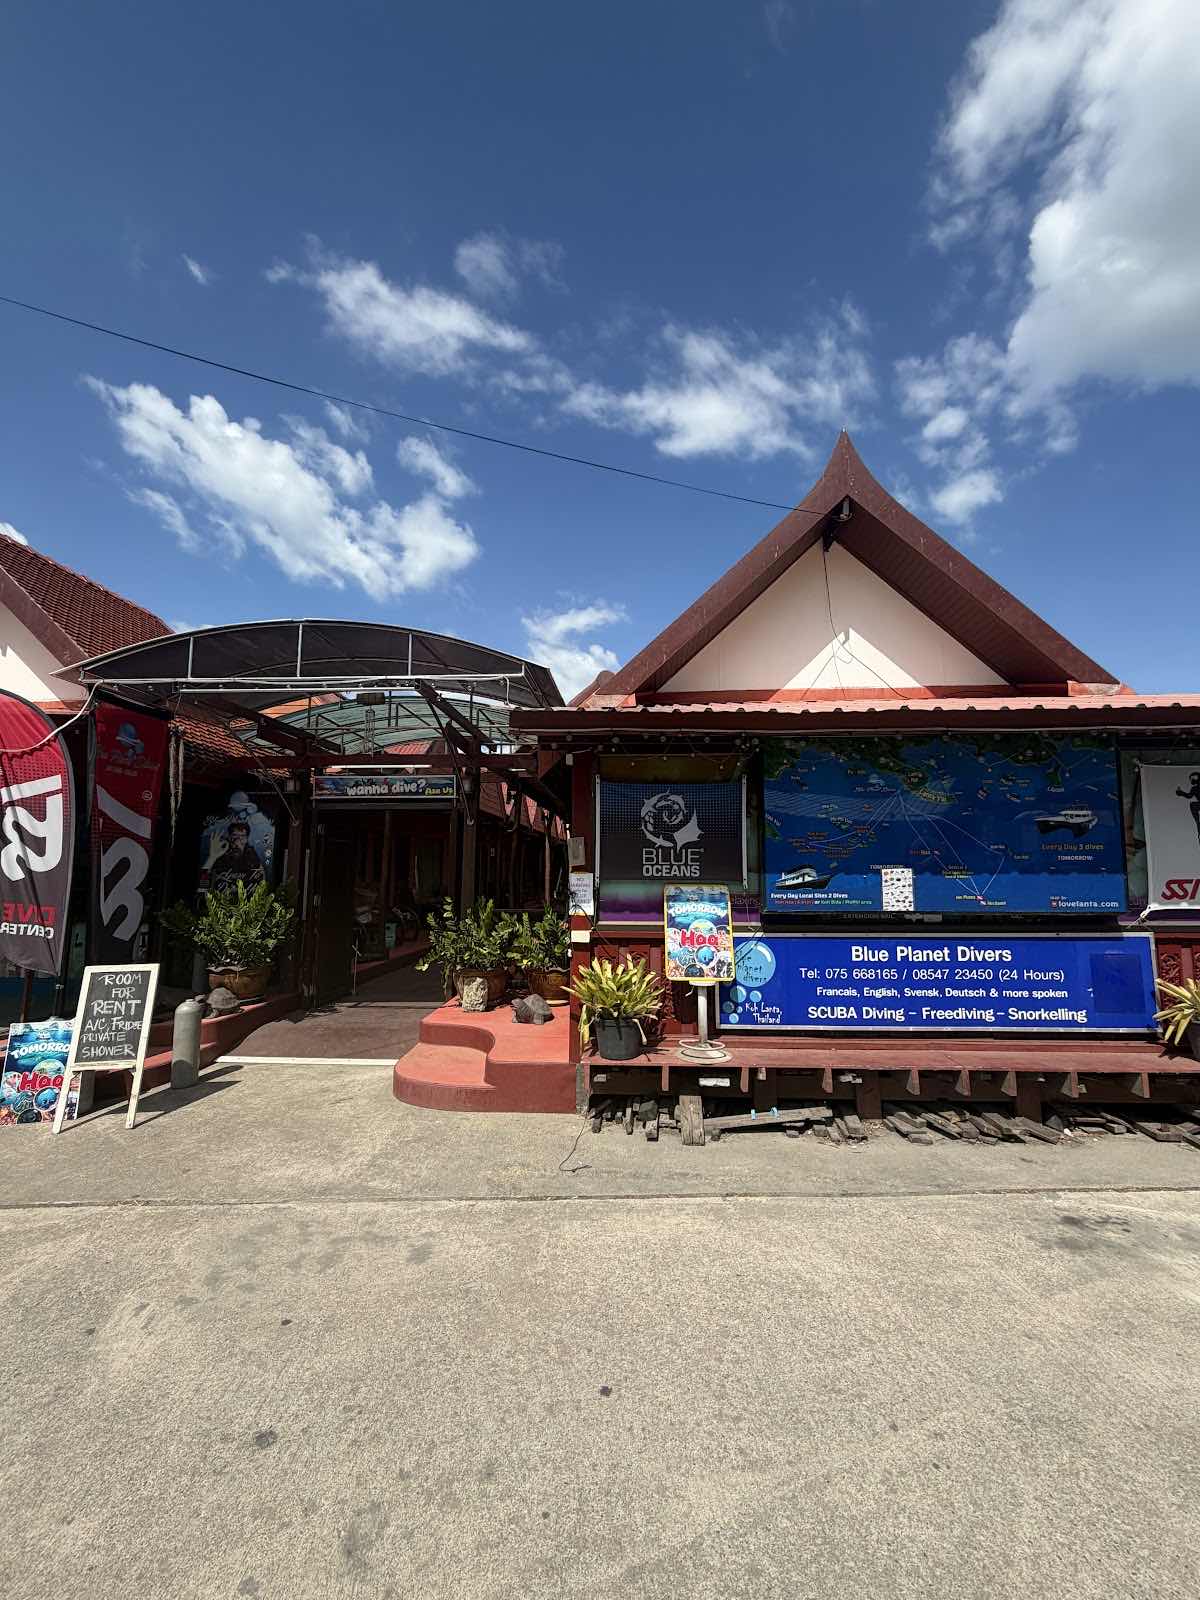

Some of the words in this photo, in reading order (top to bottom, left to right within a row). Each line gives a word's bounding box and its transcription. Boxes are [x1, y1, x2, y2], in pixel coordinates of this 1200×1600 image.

[346, 783, 389, 796] wanna
[391, 779, 426, 794] dive?
[642, 848, 701, 865] BLUE
[642, 865, 701, 877] OCEANS
[669, 904, 729, 919] TOMORROW
[851, 945, 889, 961] Blue
[897, 946, 950, 962] Planet
[957, 946, 1012, 962] Divers
[97, 973, 141, 985] ROOM
[800, 968, 820, 979] Tel:
[825, 969, 848, 979] 075
[852, 969, 898, 979] 668165
[902, 969, 907, 980] /
[912, 969, 949, 980] 08547
[955, 969, 993, 980] 23450
[999, 969, 1018, 982] (24
[1023, 970, 1065, 982] Hours)
[112, 987, 135, 999] FOR
[816, 987, 860, 998] Francais,
[864, 987, 900, 998] English,
[904, 988, 943, 998] Svensk,
[945, 988, 986, 997] Deutsch
[989, 989, 999, 997] &
[1002, 990, 1029, 998] more
[1031, 989, 1068, 999] spoken
[91, 999, 141, 1016] RENT
[745, 1002, 759, 1012] Koh
[753, 1013, 781, 1024] Thailand
[808, 1006, 857, 1019] SCUBA
[862, 1006, 905, 1021] Diving
[922, 1007, 995, 1022] Freediving
[1008, 1008, 1087, 1023] Snorkelling
[80, 1028, 127, 1043] PRIVATE
[10, 1041, 71, 1058] TOMORRO
[82, 1044, 136, 1058] SHOWER
